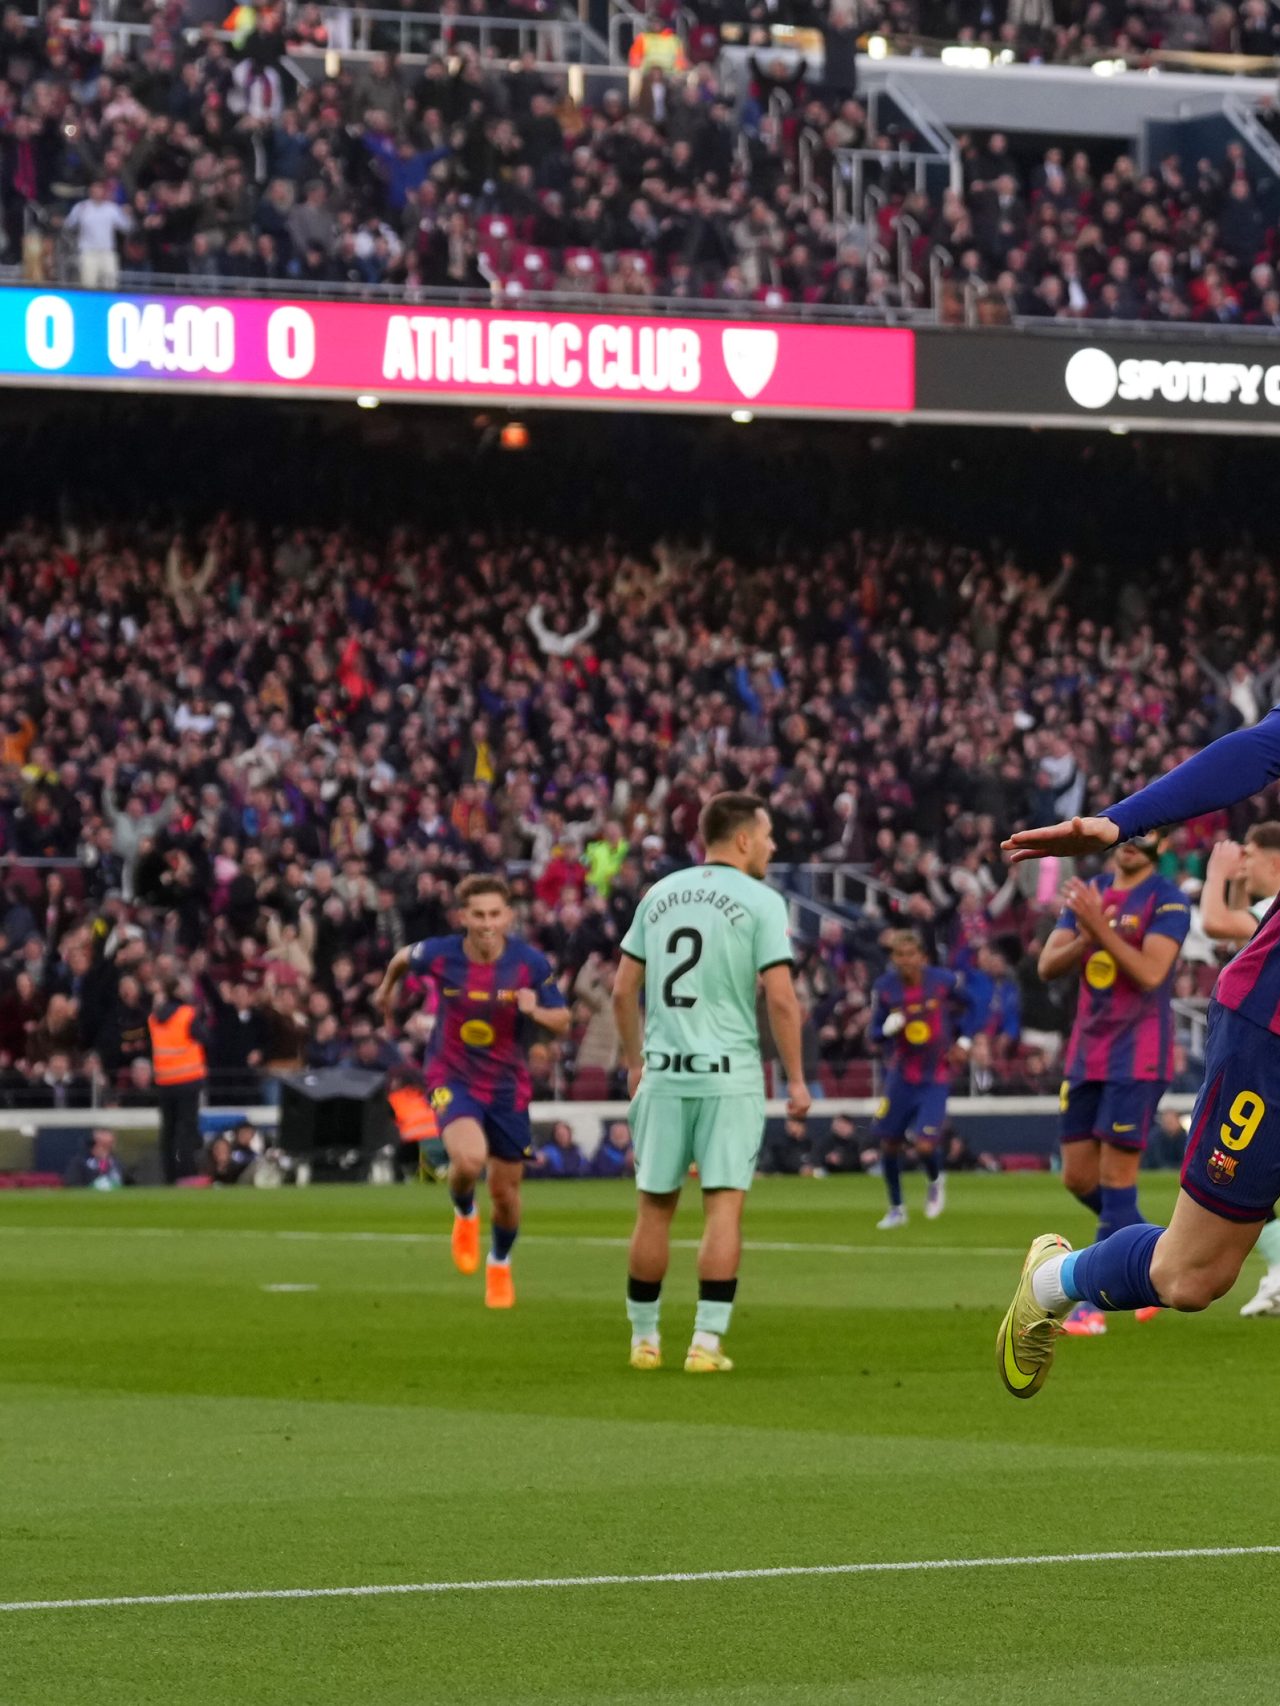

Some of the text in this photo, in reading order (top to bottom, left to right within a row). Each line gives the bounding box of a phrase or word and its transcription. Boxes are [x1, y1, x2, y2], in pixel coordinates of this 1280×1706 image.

[26, 296, 701, 392] 0 04:00 0 ATHLETIC CLUB
[1117, 359, 1263, 404] SPOTIFY
[648, 888, 745, 927] GOROSABEL
[662, 925, 703, 1009] 2
[645, 1051, 731, 1074] DIGI
[1220, 1090, 1266, 1151] 9
